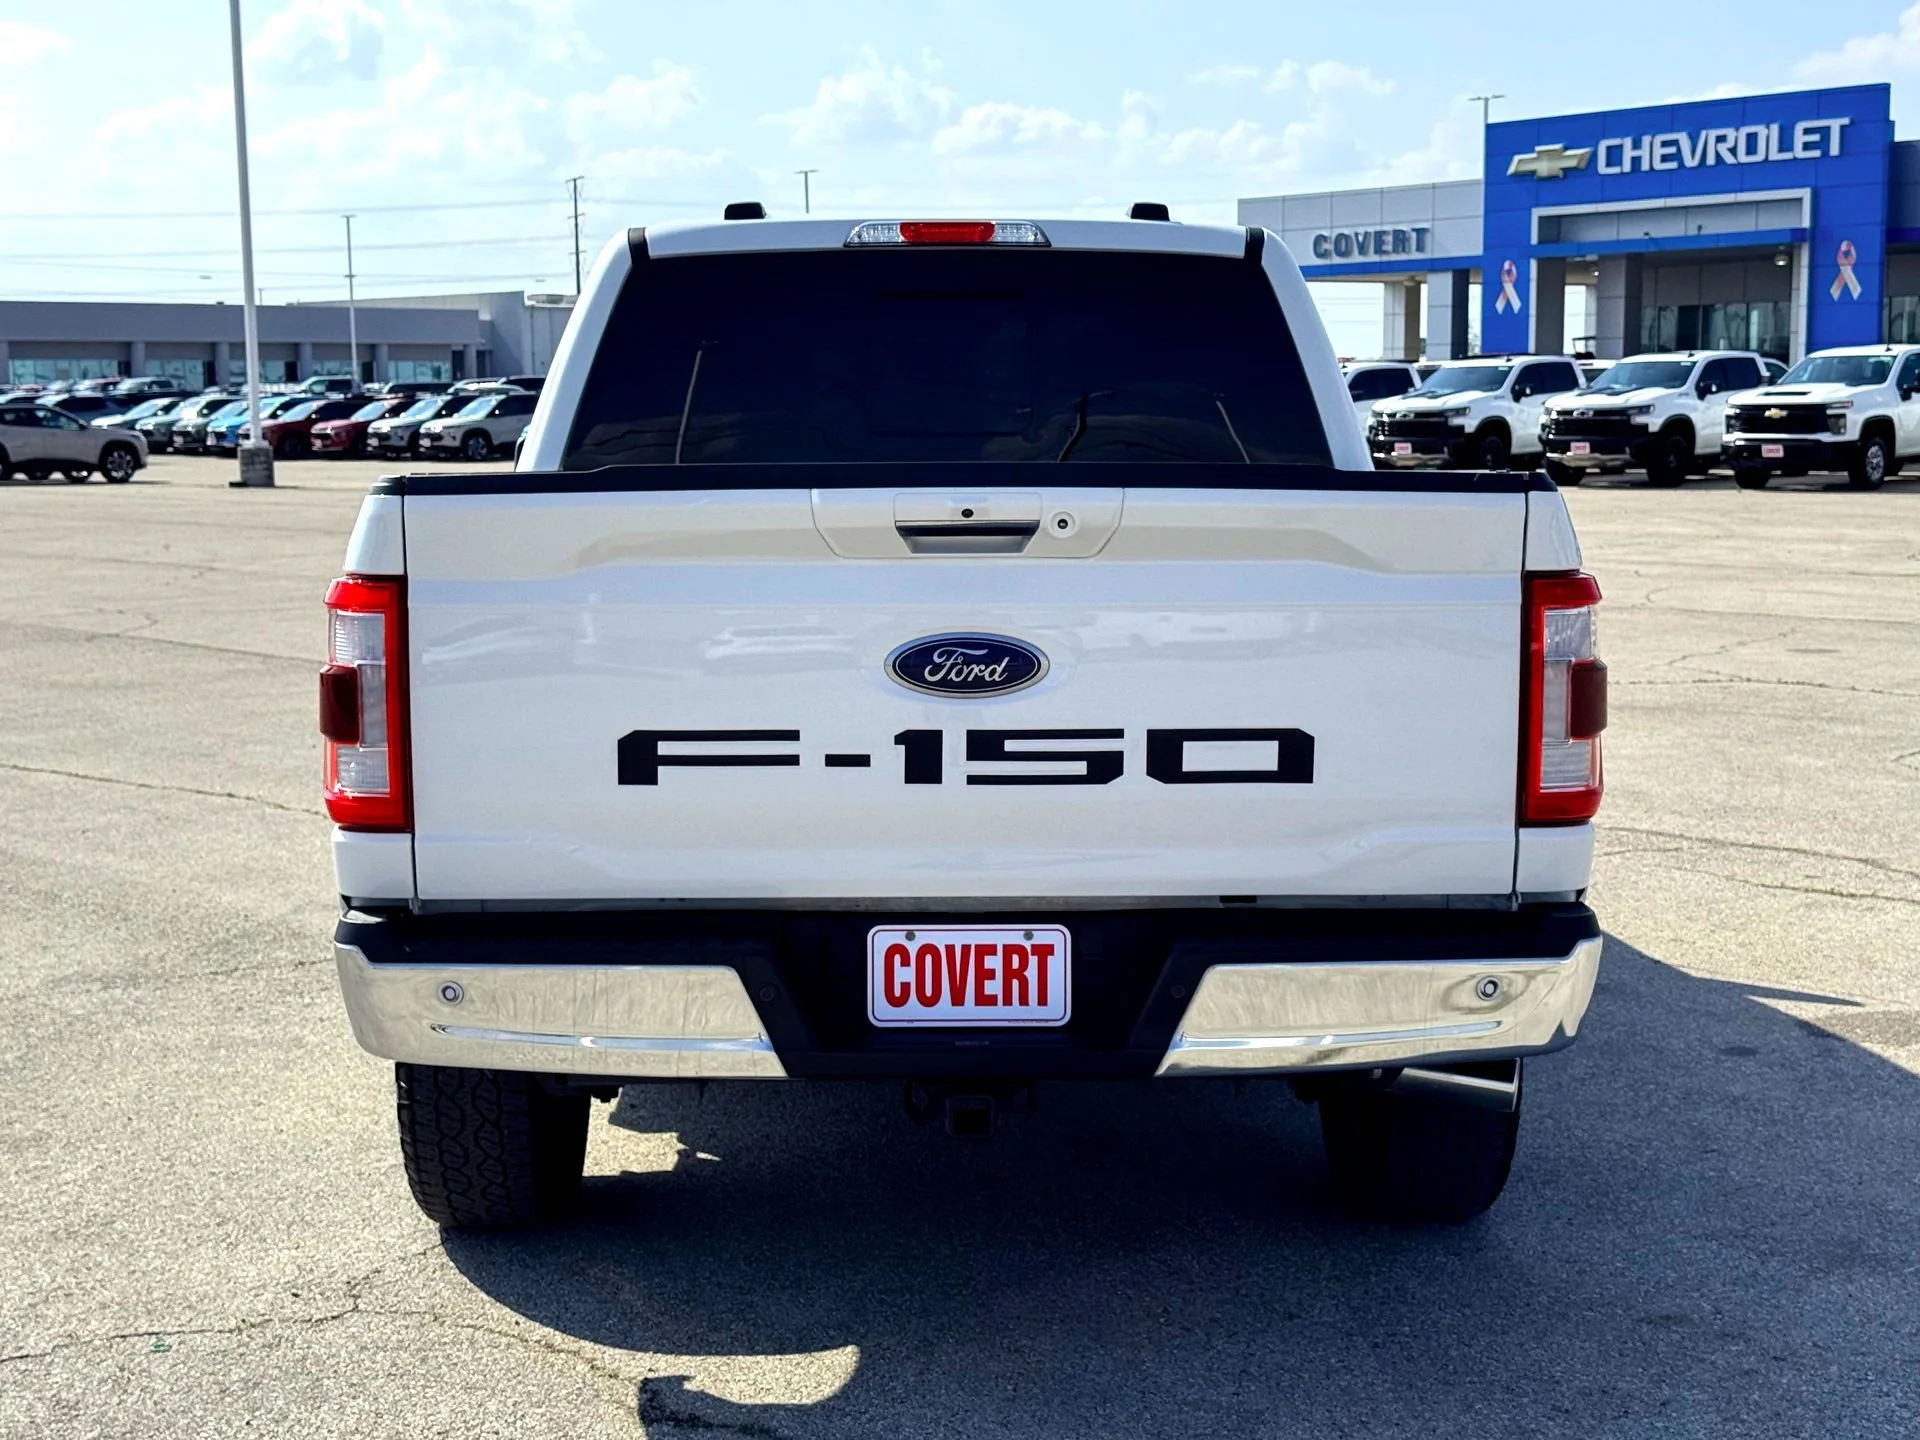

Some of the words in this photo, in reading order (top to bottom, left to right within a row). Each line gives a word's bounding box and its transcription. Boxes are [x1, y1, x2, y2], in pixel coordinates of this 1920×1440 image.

[1597, 117, 1850, 175] CHEVROLET
[1313, 227, 1430, 259] COVERT
[924, 647, 1010, 682] Ford
[617, 728, 1315, 786] F-150
[883, 943, 1055, 1008] COVERT
